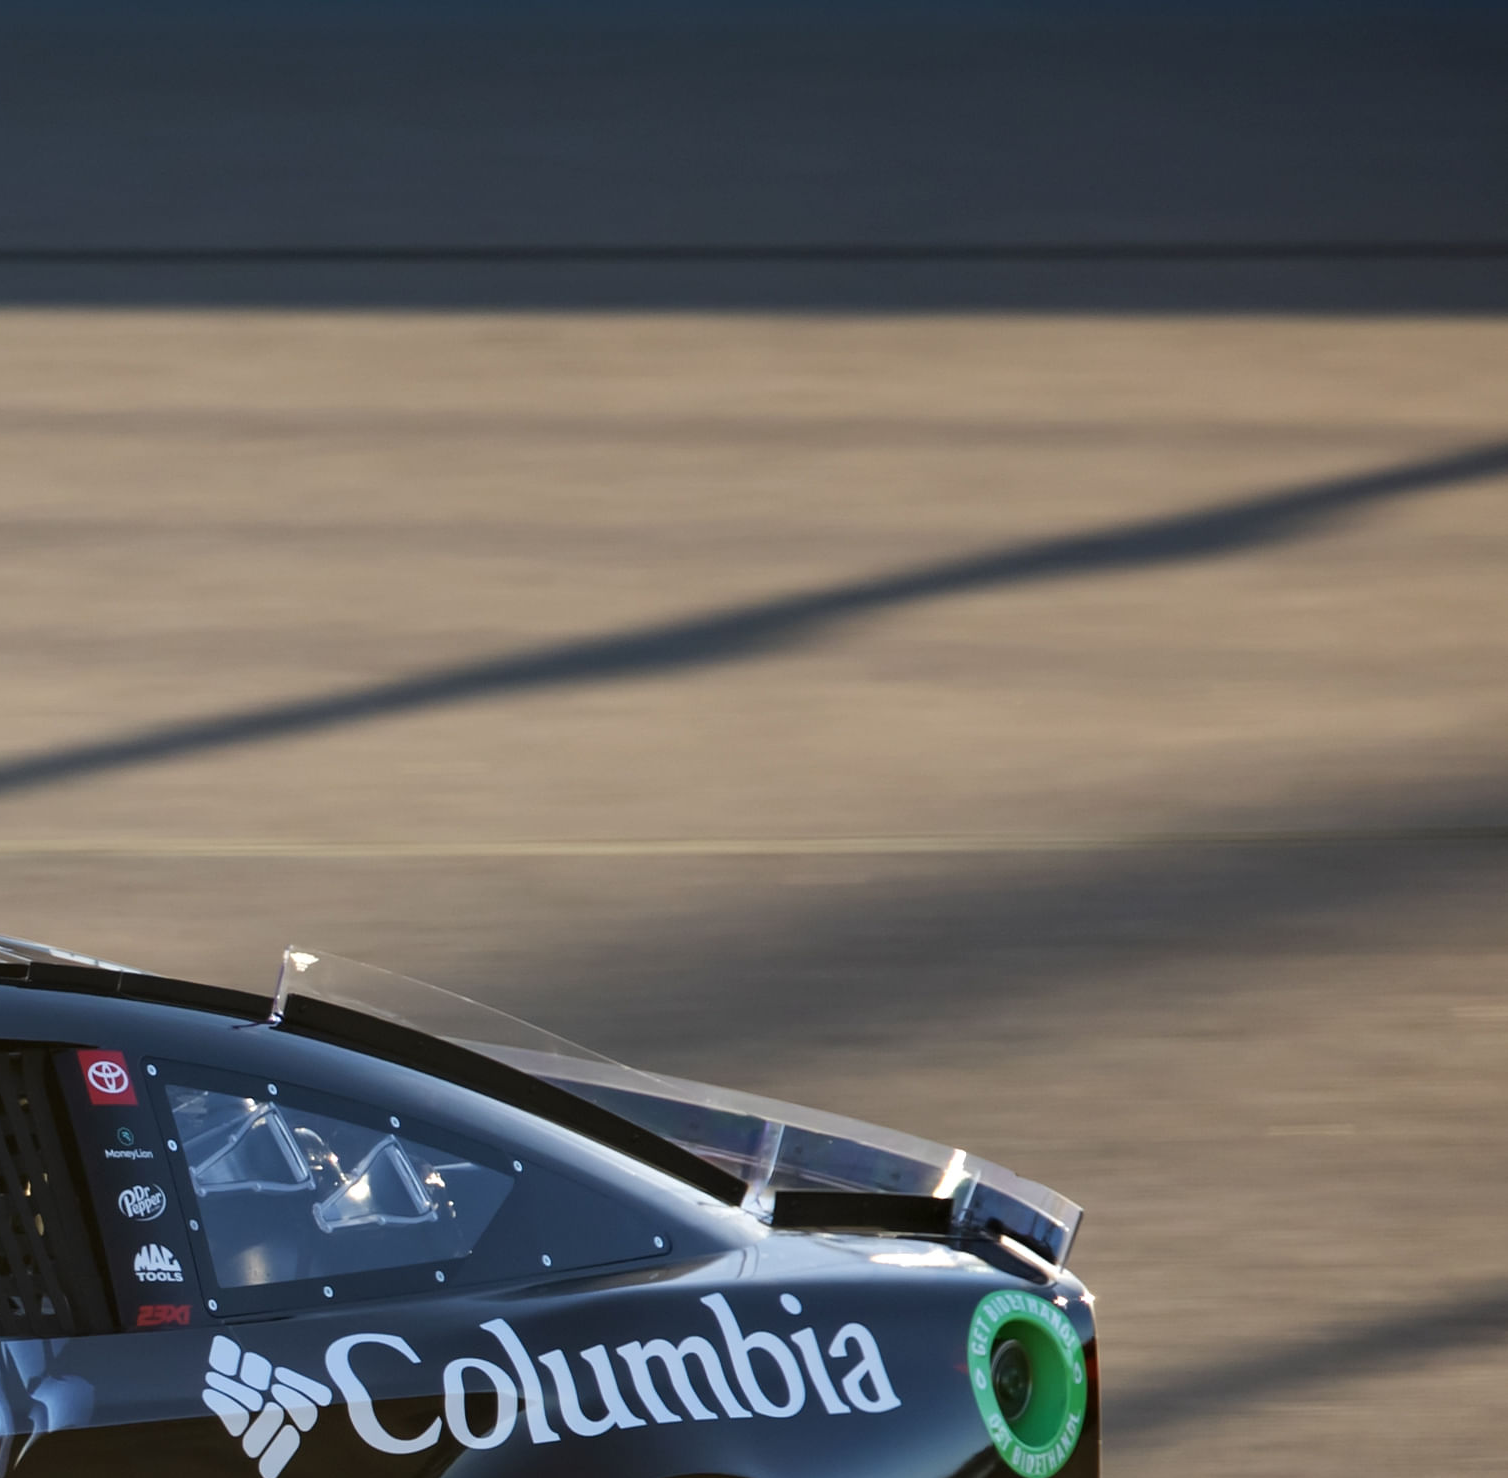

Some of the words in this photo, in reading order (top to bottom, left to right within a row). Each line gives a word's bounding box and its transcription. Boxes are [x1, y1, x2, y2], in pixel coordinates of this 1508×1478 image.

[105, 1148, 154, 1160] MoneyLion
[125, 1188, 162, 1218] Pepper
[133, 1185, 151, 1202] Dr
[134, 1243, 181, 1271] MAC
[136, 1271, 184, 1282] TOOLS
[971, 1318, 991, 1357] GET
[325, 1291, 902, 1456] Columbia
